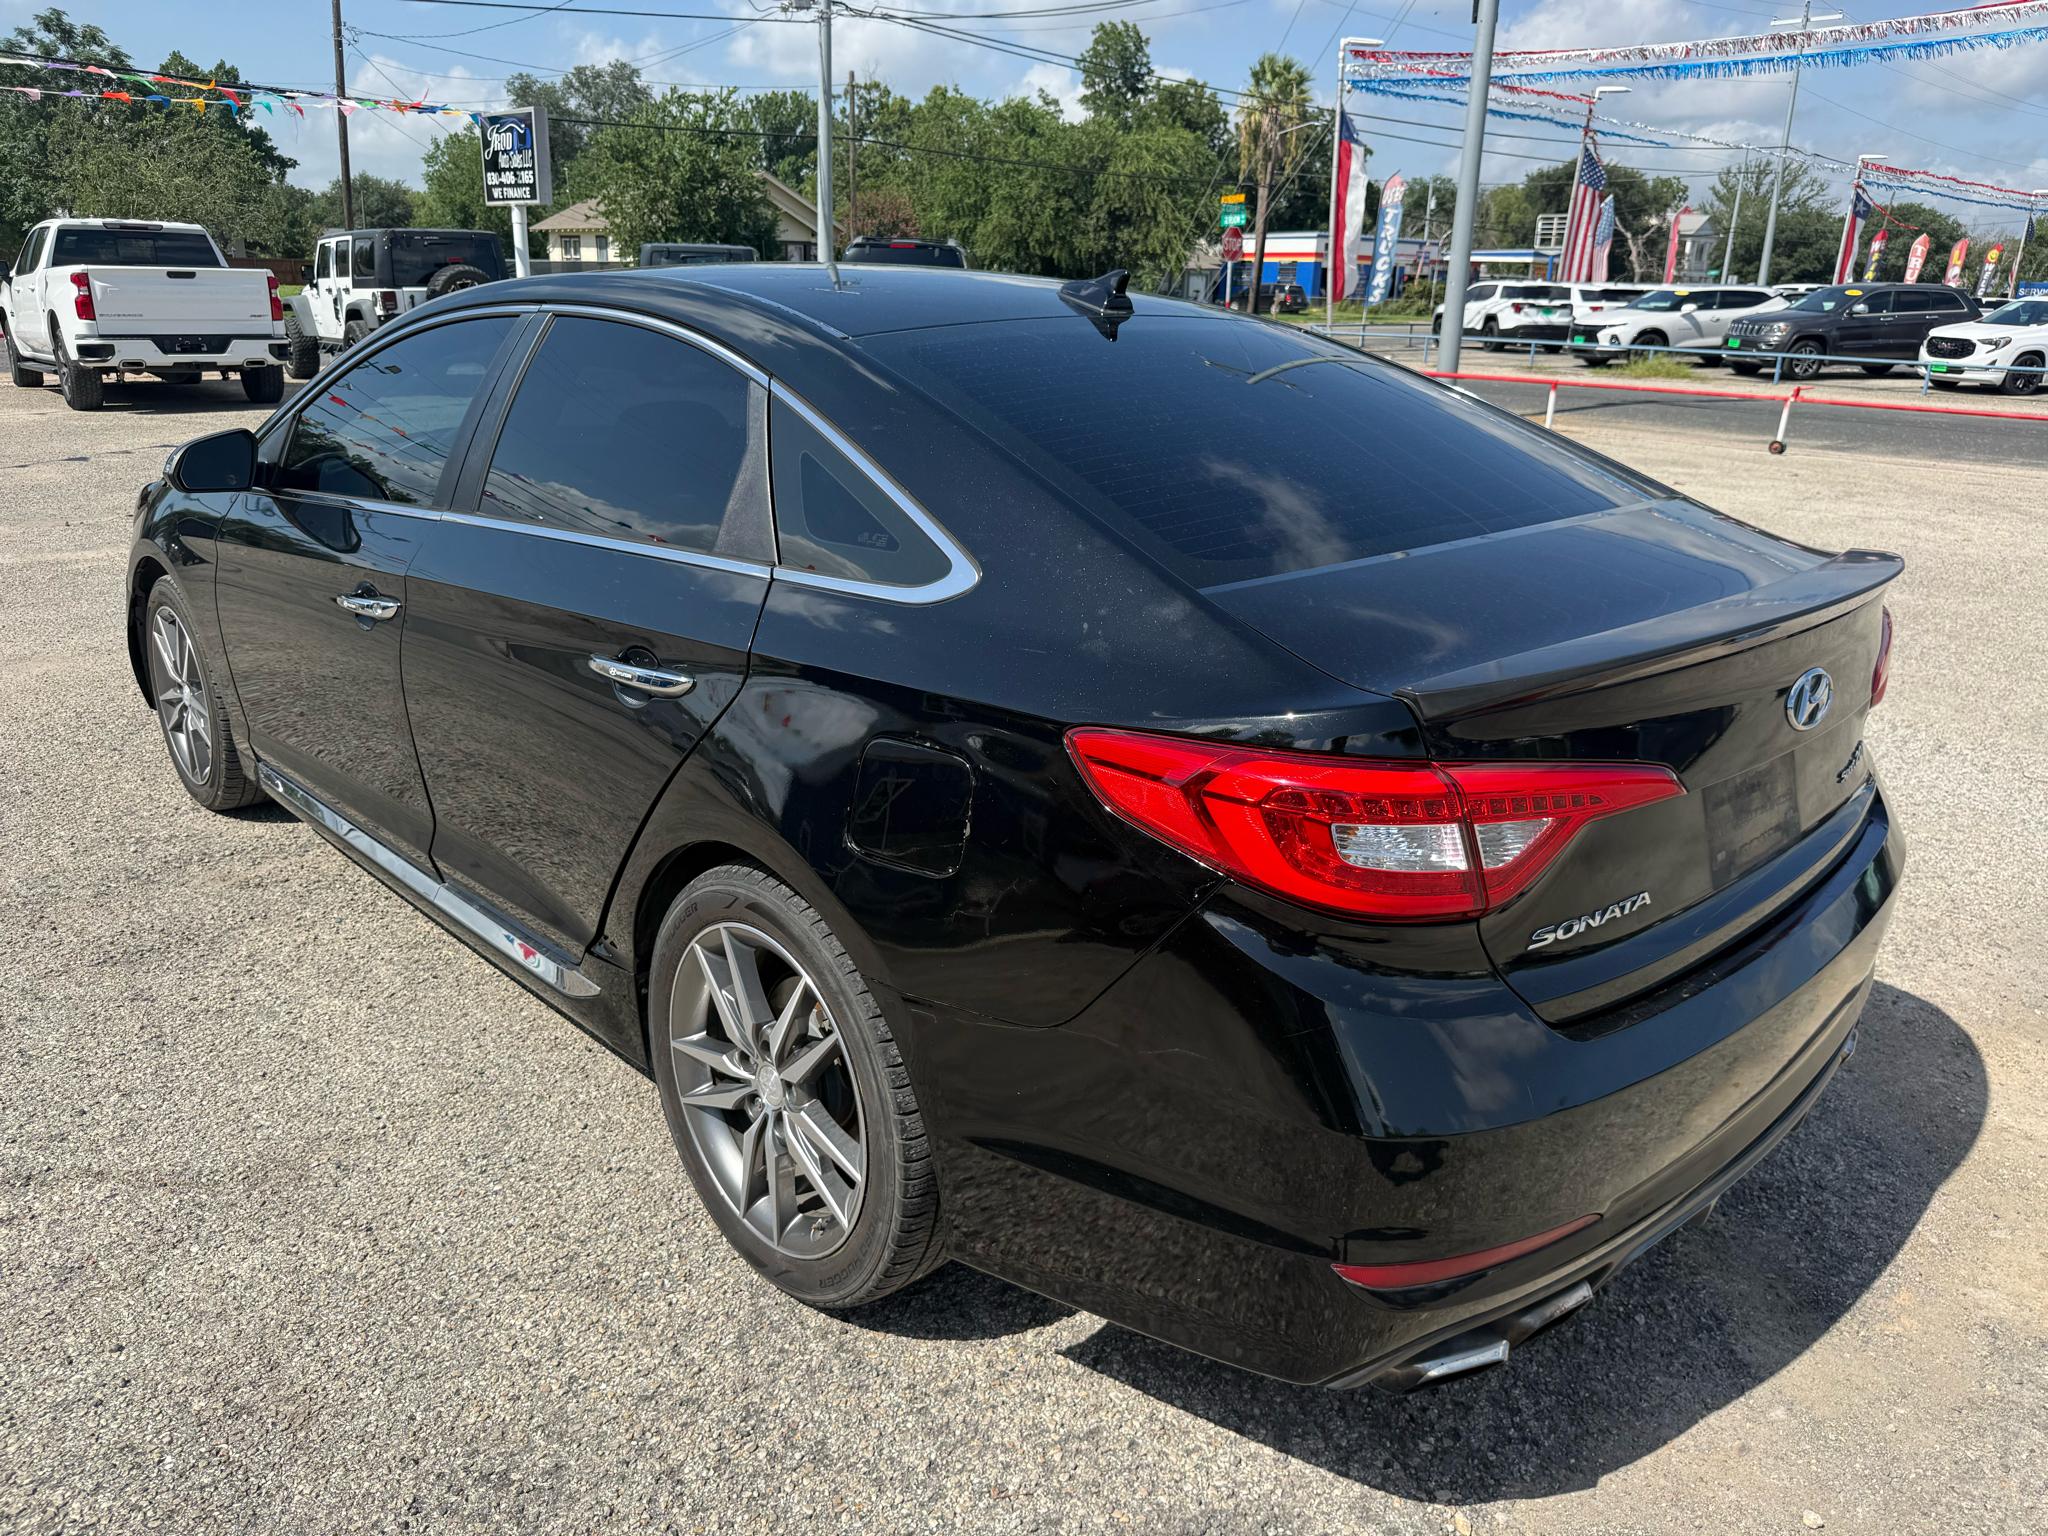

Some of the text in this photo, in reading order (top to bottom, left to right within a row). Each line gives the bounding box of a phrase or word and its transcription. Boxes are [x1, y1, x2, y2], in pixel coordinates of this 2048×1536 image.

[492, 187, 531, 199] WE FINANCE
[1224, 237, 1242, 251] STOP
[1368, 207, 1399, 302] TRUCKS
[1905, 244, 1926, 284] TRU
[1527, 891, 1651, 951] SONATA
